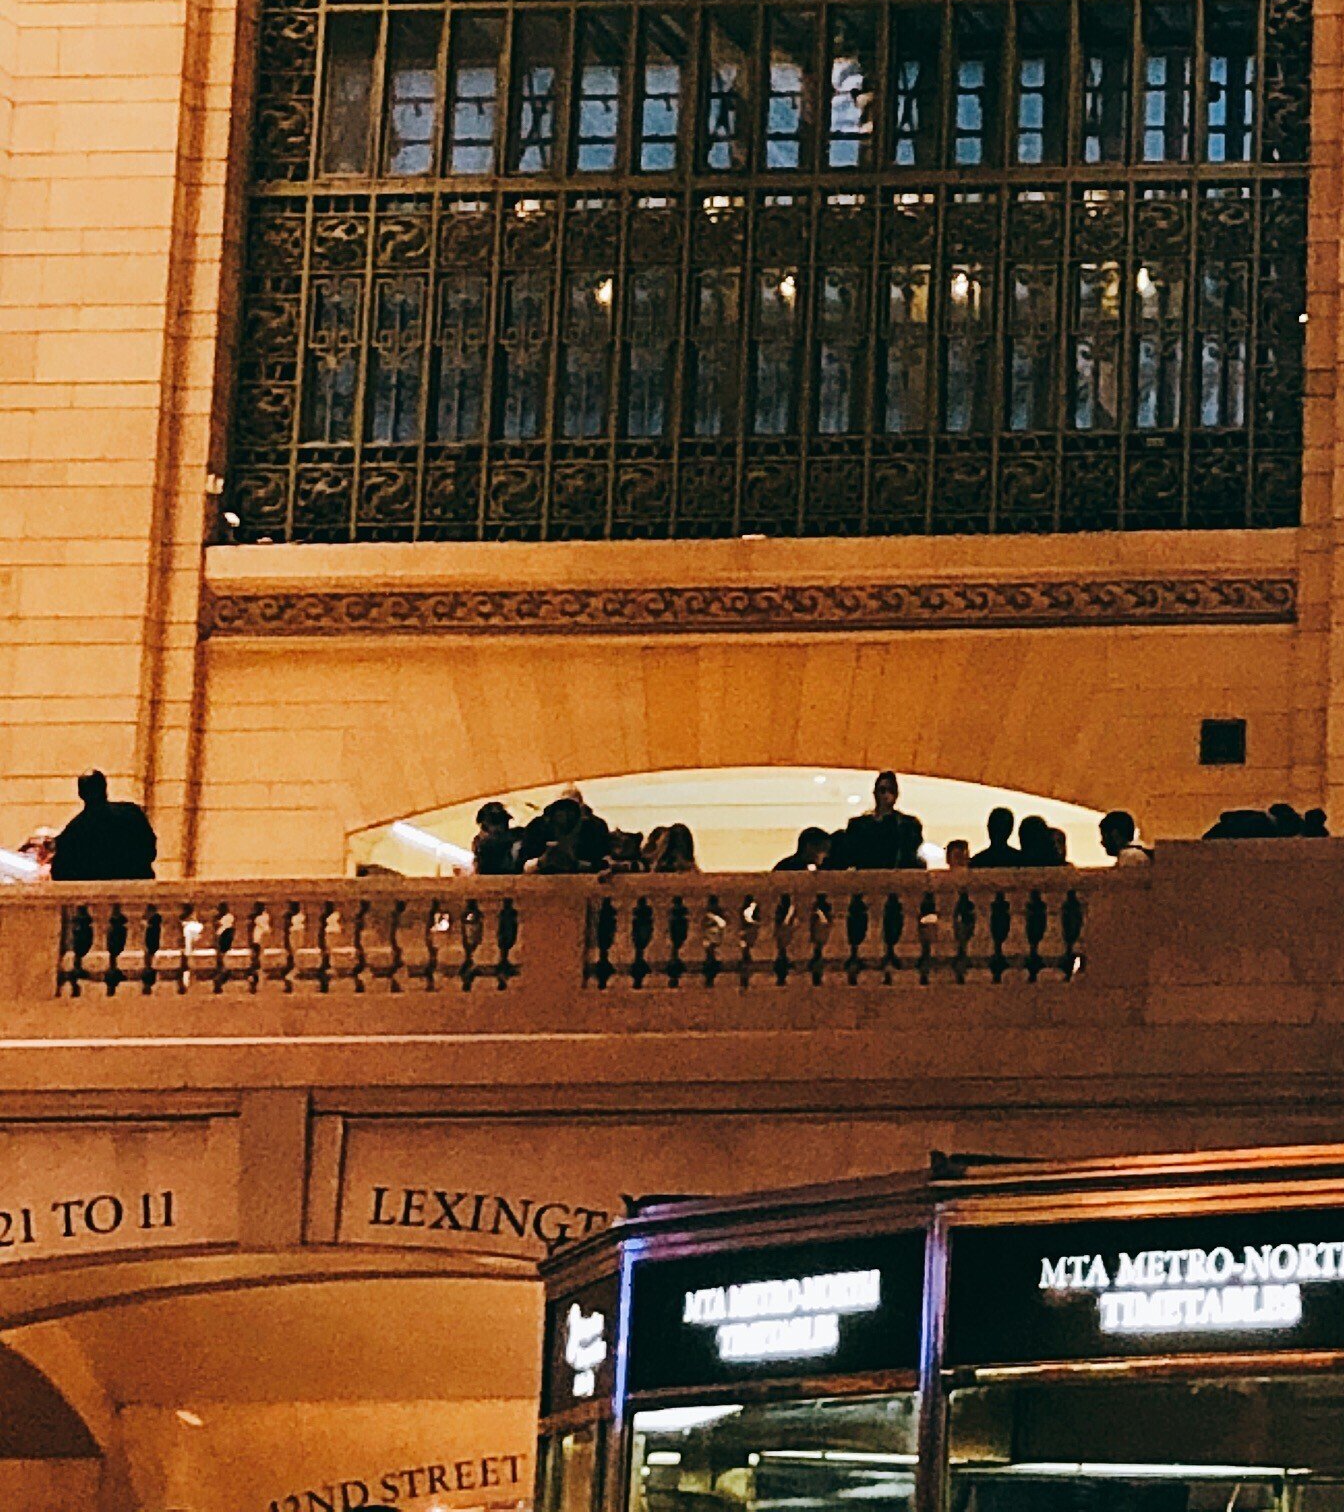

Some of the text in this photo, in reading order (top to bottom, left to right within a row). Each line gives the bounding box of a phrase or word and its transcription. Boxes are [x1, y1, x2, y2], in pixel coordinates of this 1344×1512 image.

[0, 1191, 173, 1246] 21 TO 11
[1039, 1256, 1109, 1289] MTA
[1097, 1285, 1301, 1332] TIMETABLES
[380, 1453, 526, 1504] STREET
